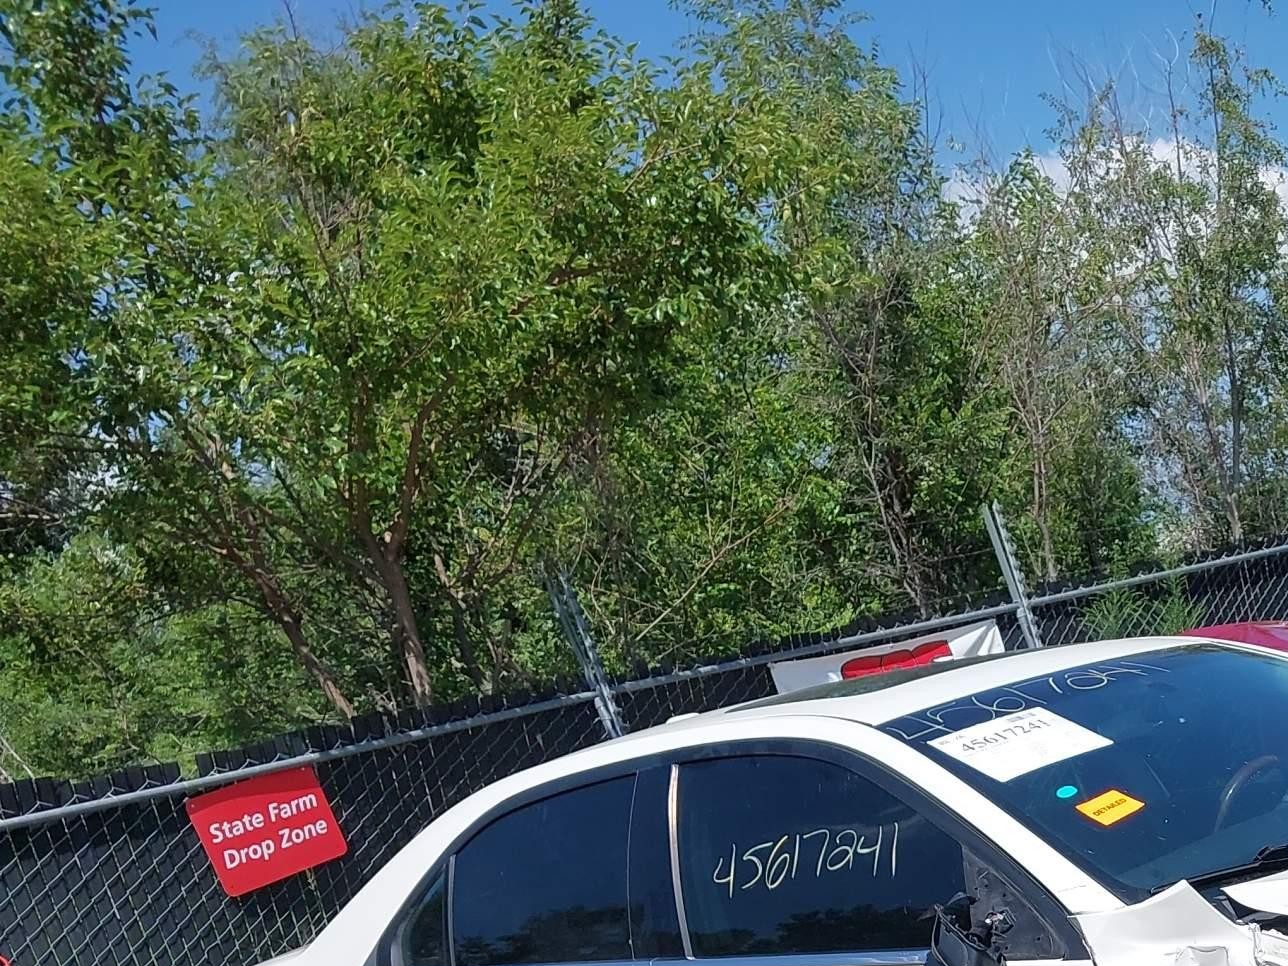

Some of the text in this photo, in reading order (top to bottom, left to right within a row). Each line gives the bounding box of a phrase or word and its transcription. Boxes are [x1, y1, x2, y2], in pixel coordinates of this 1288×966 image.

[961, 719, 1052, 752] 45617241
[209, 793, 318, 844] State Farm
[1092, 797, 1128, 817] DETAILED
[223, 819, 328, 870] Drop Zone
[712, 822, 899, 899] 45617241
